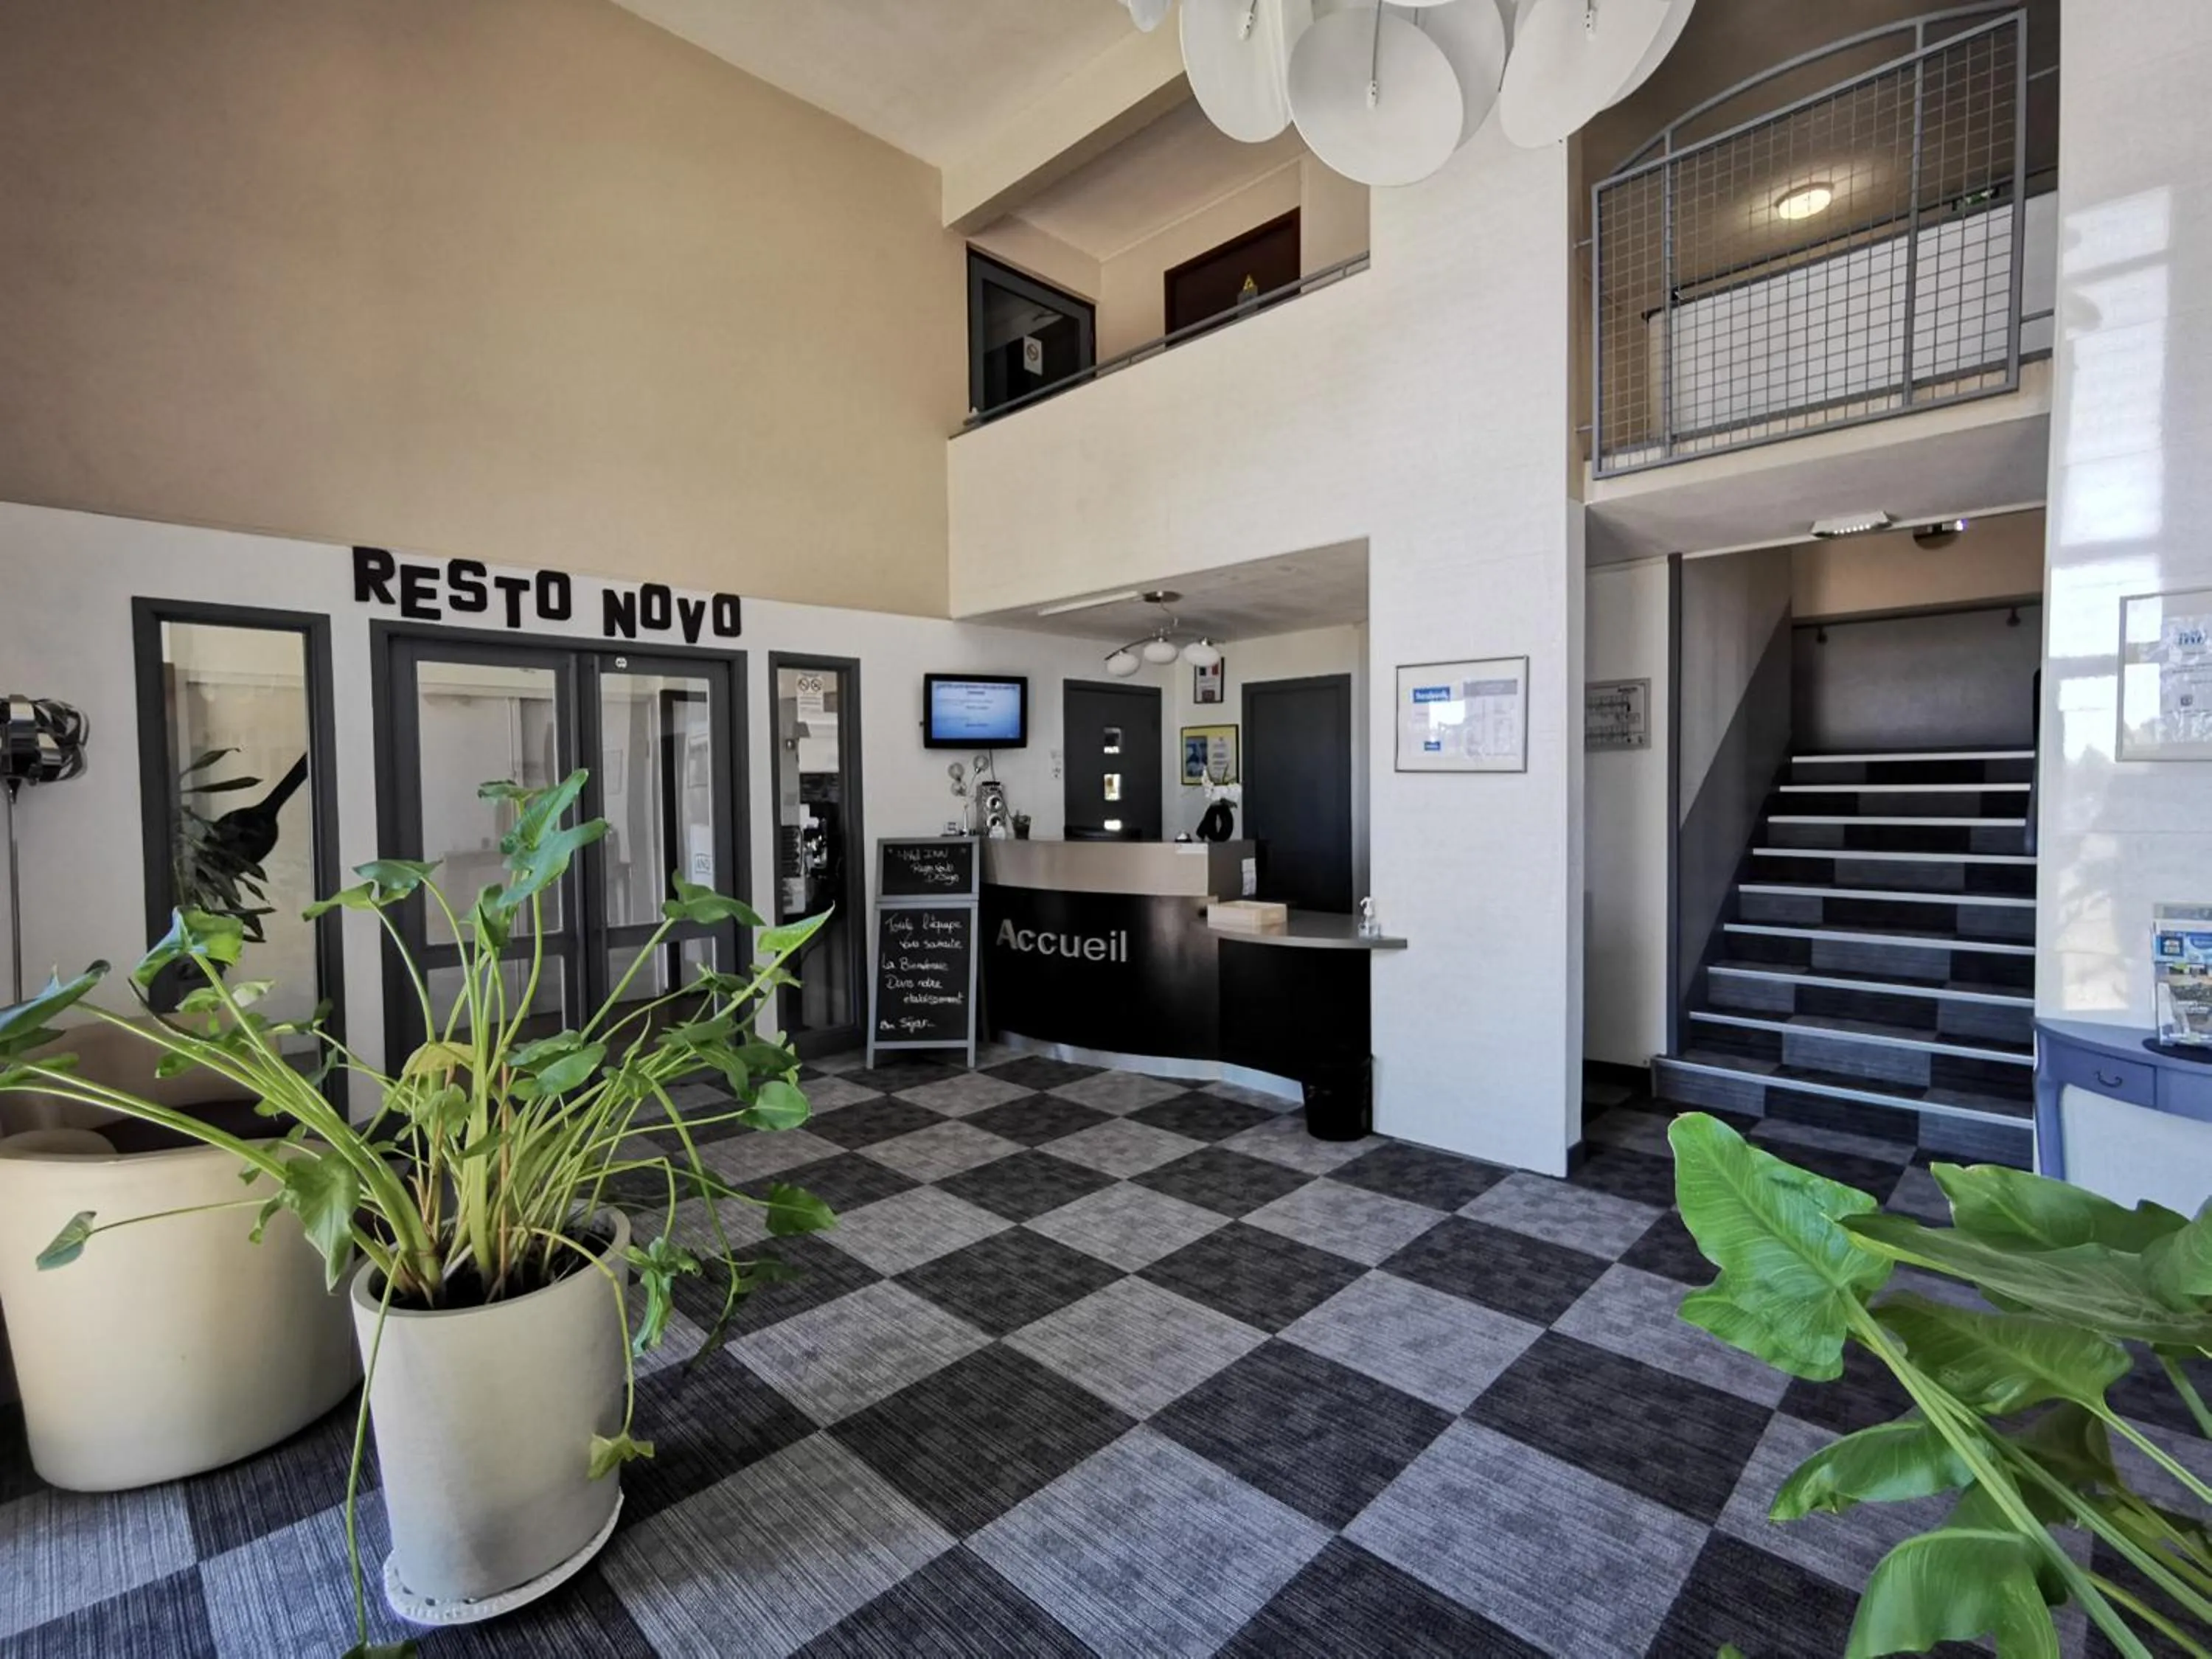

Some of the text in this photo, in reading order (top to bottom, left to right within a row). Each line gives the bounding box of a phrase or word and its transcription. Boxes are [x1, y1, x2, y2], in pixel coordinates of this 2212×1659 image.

[352, 546, 742, 644] RESTO NOVO
[995, 918, 1127, 963] Accueil
